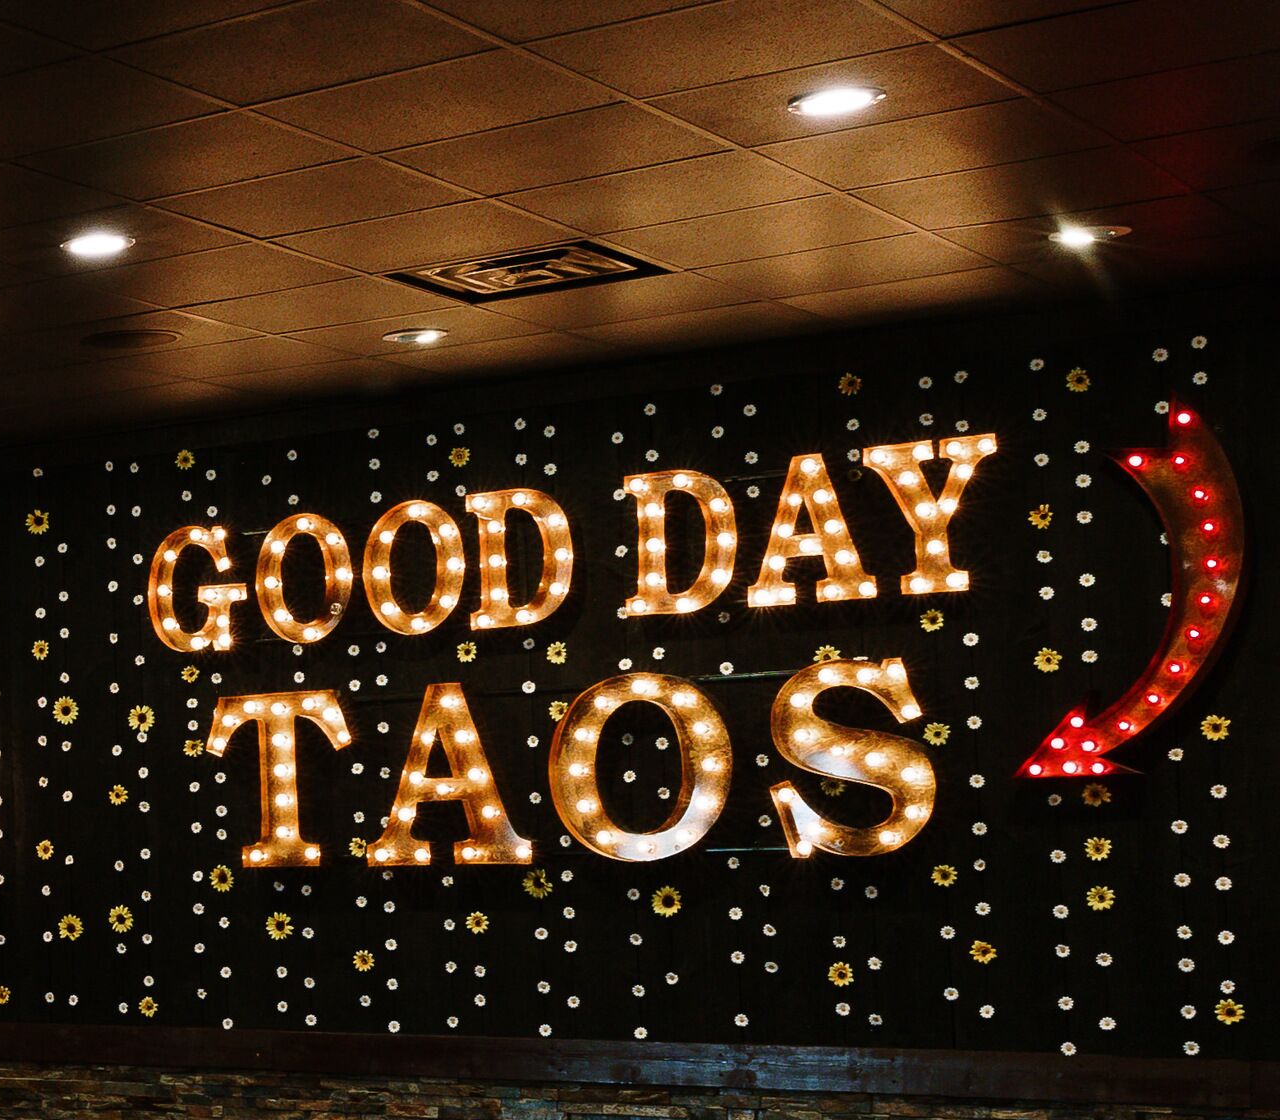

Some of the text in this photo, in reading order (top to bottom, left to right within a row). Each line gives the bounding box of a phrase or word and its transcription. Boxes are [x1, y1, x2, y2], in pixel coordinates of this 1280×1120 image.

[149, 433, 998, 653] GOOD DAY
[206, 658, 937, 867] TAOS
